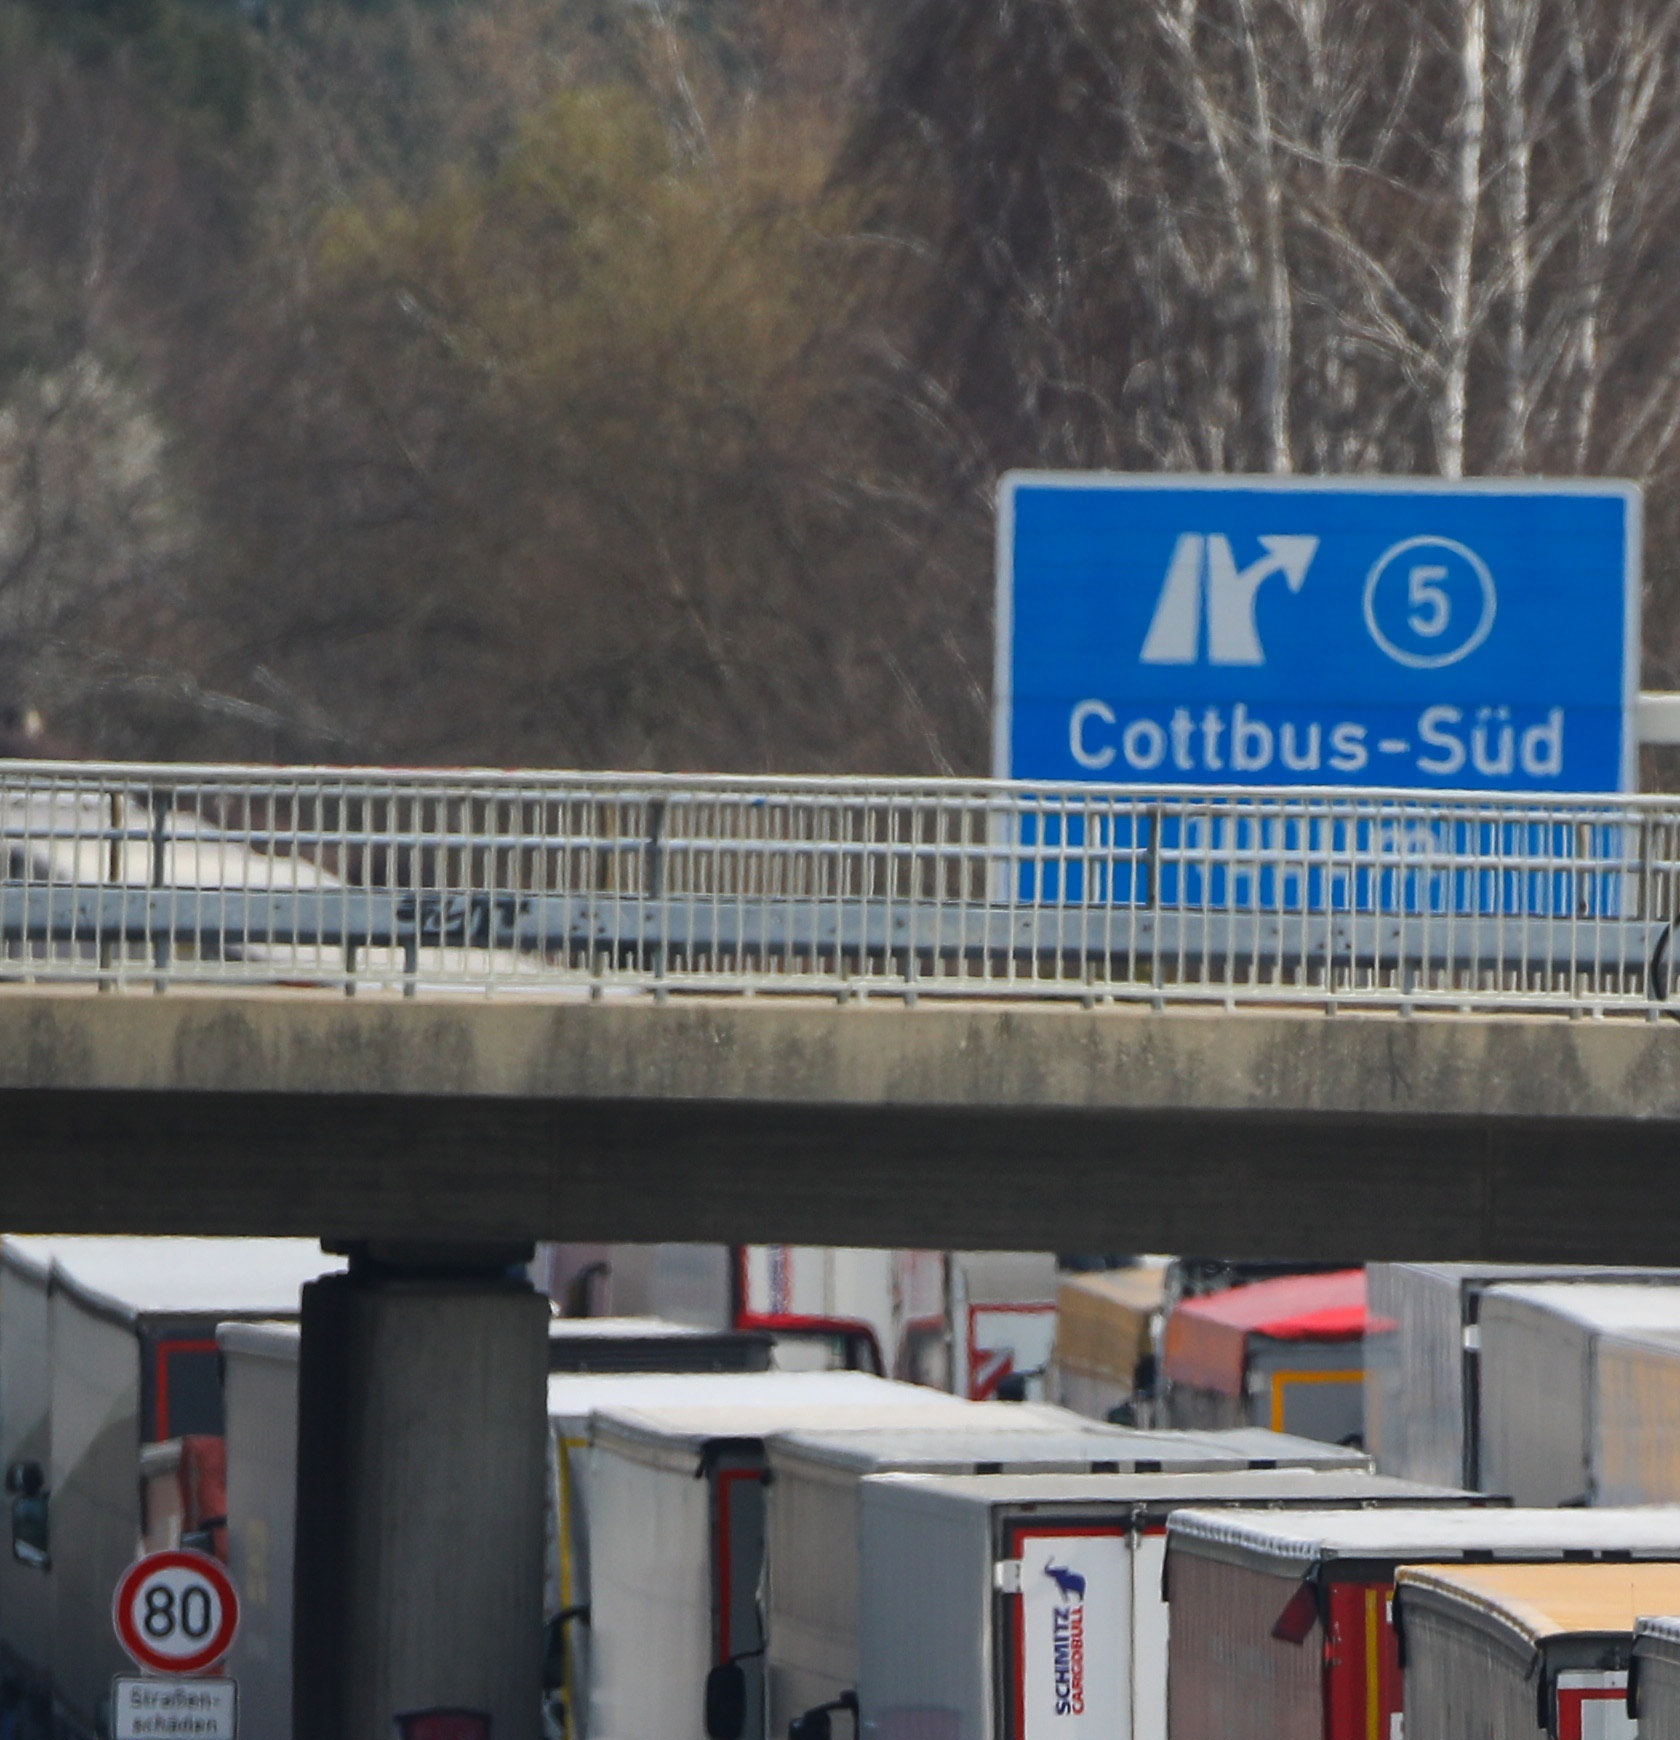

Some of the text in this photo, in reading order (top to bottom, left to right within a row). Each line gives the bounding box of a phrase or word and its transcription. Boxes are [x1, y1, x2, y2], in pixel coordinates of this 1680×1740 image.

[1406, 566, 1451, 638] 5
[1068, 699, 1564, 777] Cottbus-Süd
[145, 1585, 212, 1638] 80
[1054, 1606, 1070, 1715] SCHMITZ
[1071, 1604, 1084, 1715] CARGOBULL
